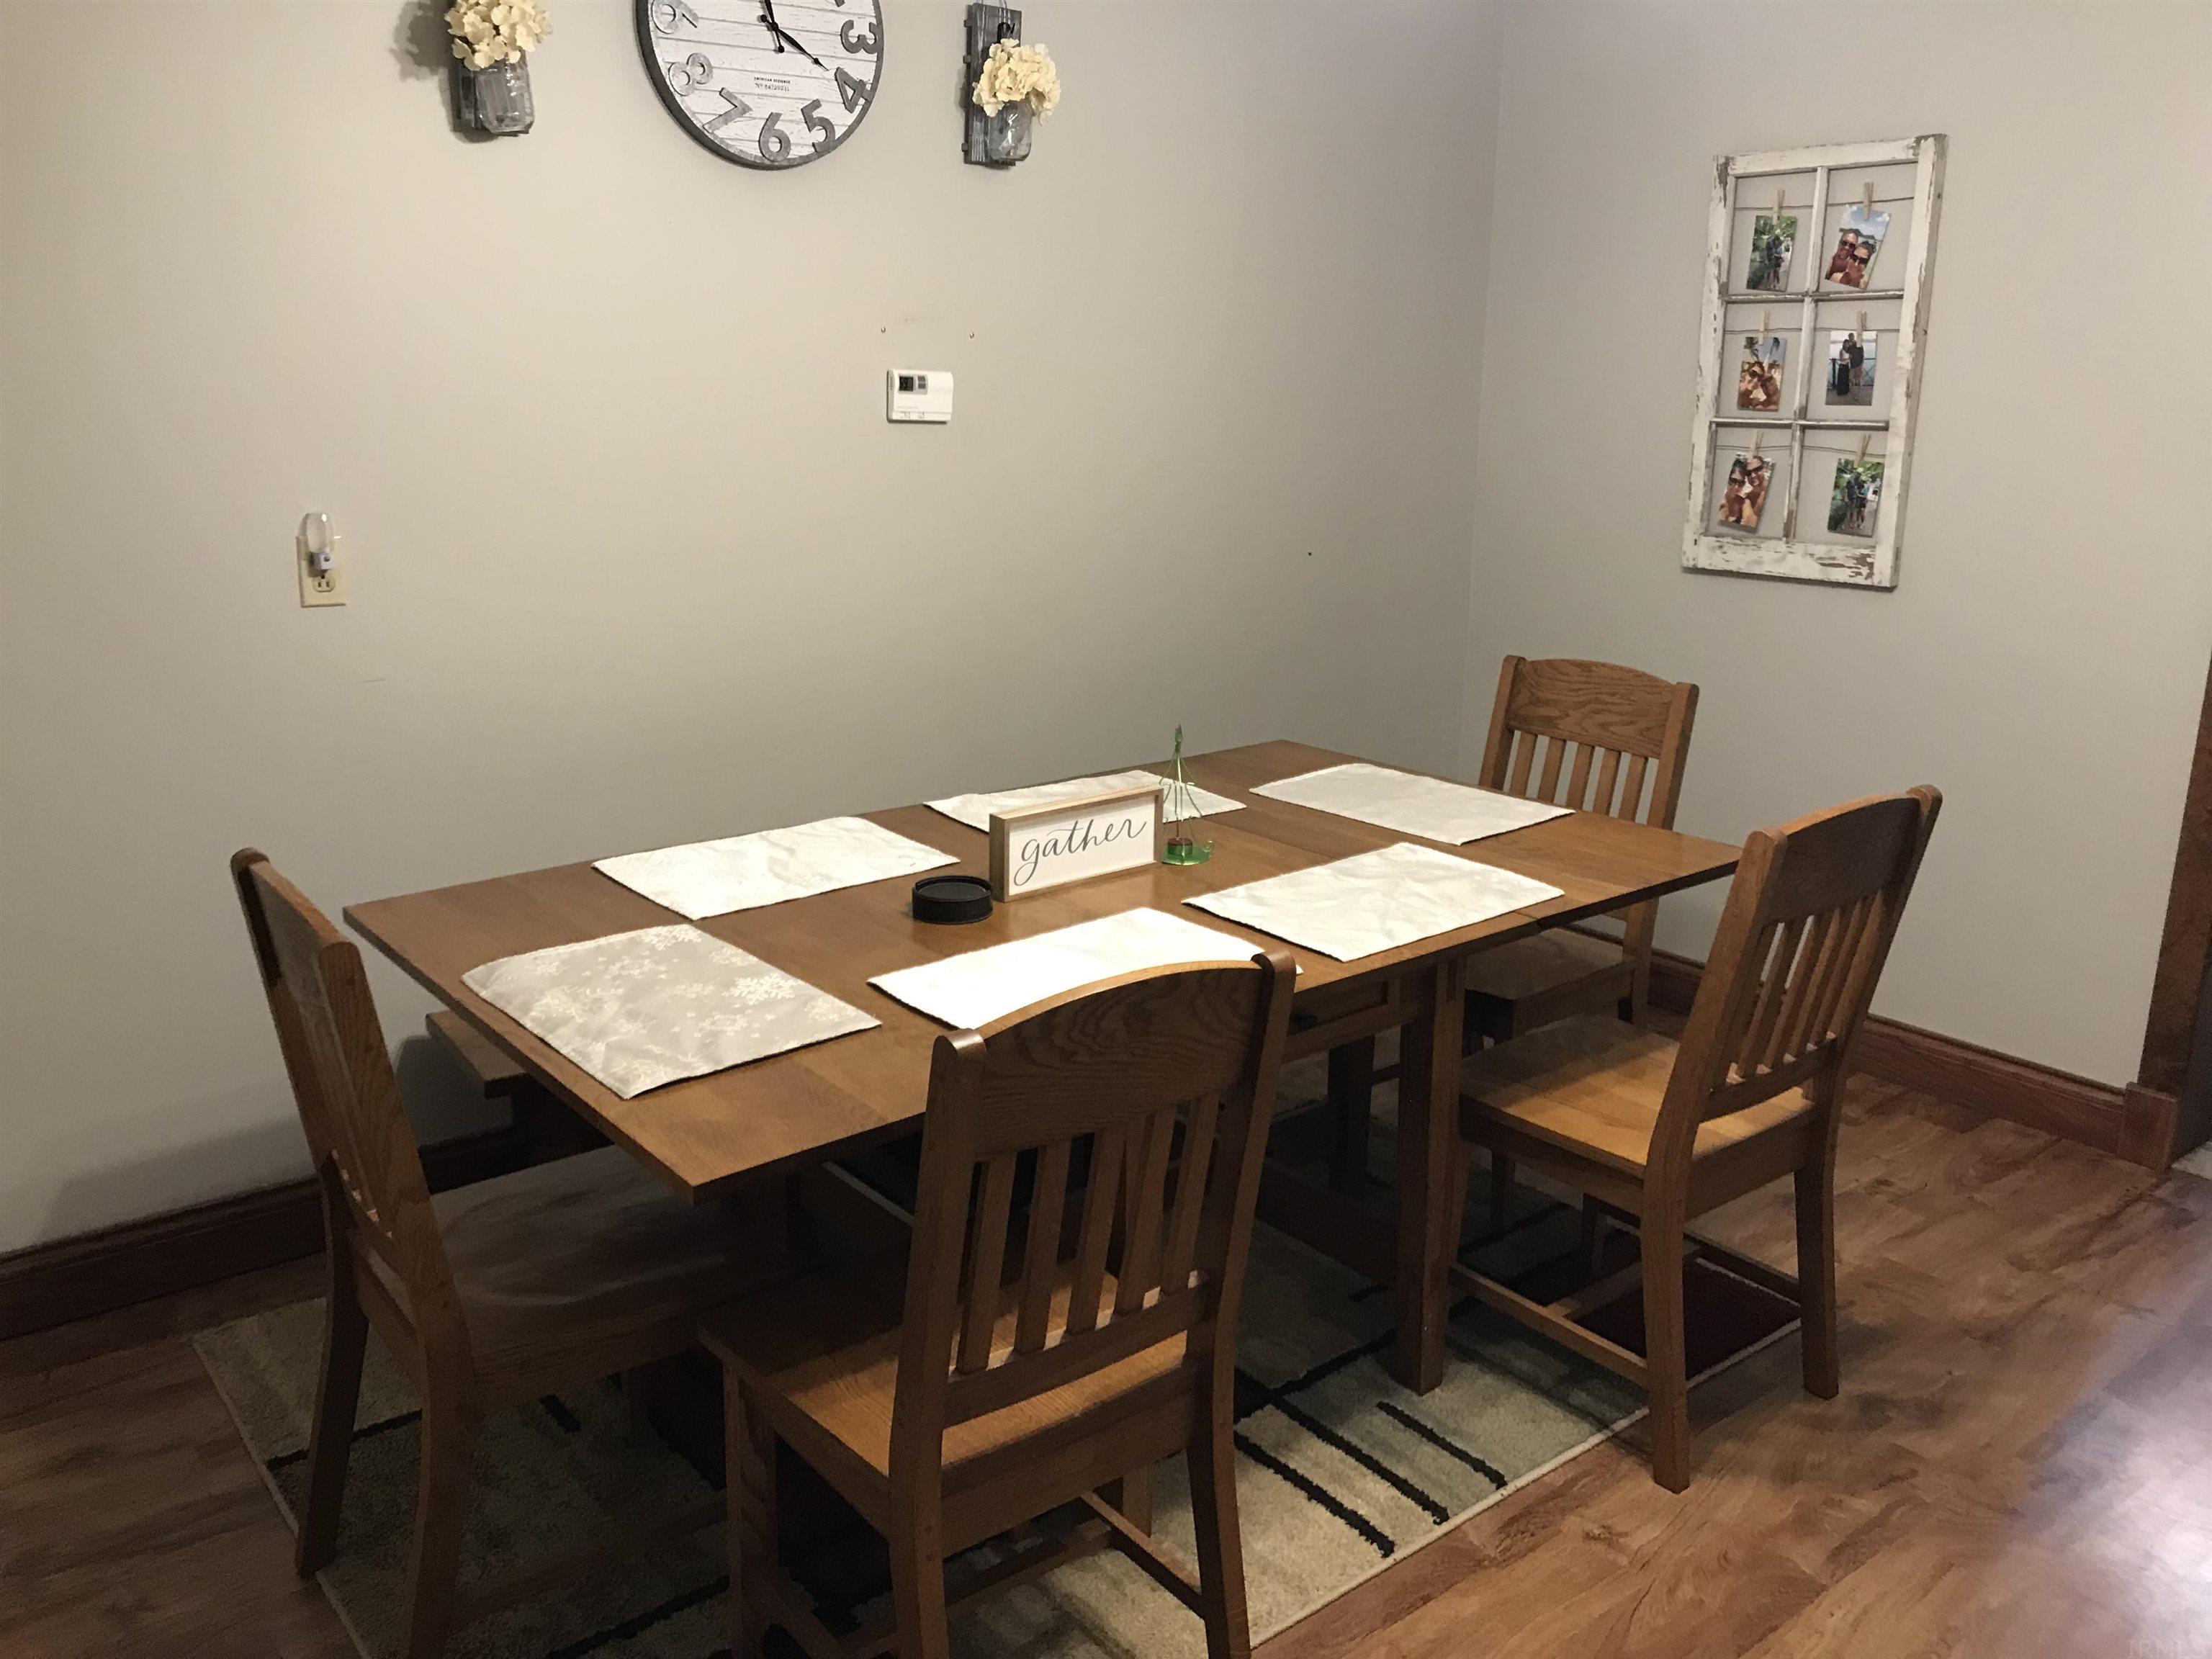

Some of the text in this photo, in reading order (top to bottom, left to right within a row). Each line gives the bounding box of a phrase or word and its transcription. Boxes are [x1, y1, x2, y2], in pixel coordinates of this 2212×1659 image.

[840, 19, 879, 54] 3
[667, 53, 713, 96] 8
[834, 66, 873, 114] 4
[702, 87, 752, 134] 7
[801, 99, 836, 153] 5
[758, 112, 791, 162] 6
[1013, 819, 1147, 886] gather
